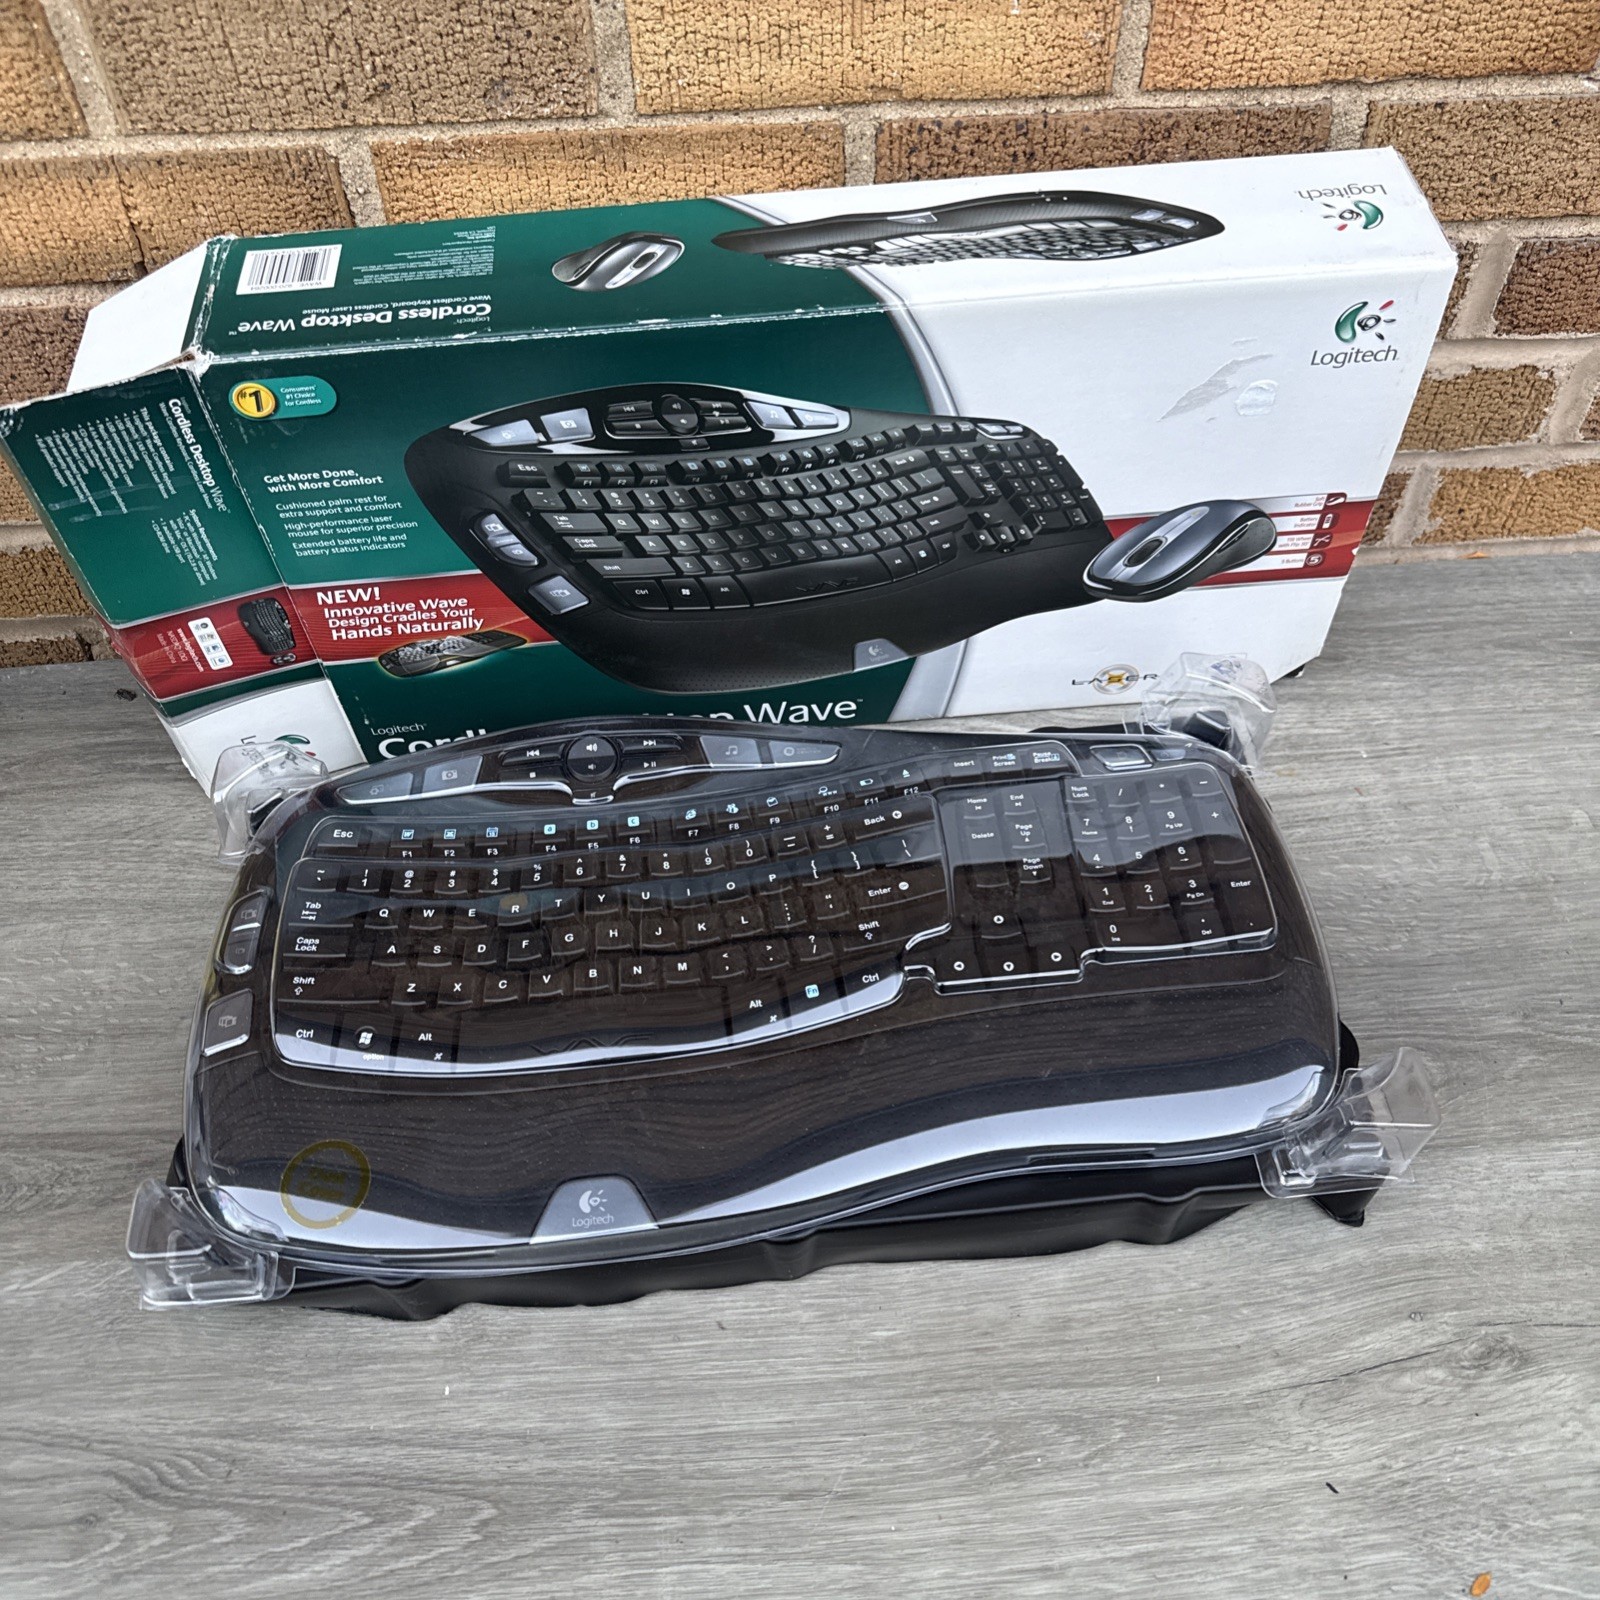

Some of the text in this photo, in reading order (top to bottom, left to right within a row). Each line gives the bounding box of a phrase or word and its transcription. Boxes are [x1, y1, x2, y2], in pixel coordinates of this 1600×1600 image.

[1298, 183, 1387, 201] Logitech
[391, 299, 431, 308] Keyboard,
[433, 296, 467, 304] Cordless
[354, 302, 388, 310] Cordless
[398, 303, 491, 320] Cordless
[301, 311, 393, 327] Desktop
[1310, 345, 1398, 369] Logitech
[294, 391, 315, 399] Choice
[295, 398, 322, 406] Cordless
[140, 407, 174, 471] This package contains
[169, 399, 196, 444] Cordless
[190, 444, 215, 486] Desktop
[159, 402, 169, 416] Wave
[166, 417, 179, 438] Cordless
[187, 461, 199, 481] Cordless
[197, 481, 205, 493] Laser
[203, 493, 212, 508] Mouse
[517, 464, 537, 472] Esc
[264, 470, 358, 484] Get More Done,
[268, 475, 384, 493] with More Comfort
[276, 500, 326, 511] Cushioned
[328, 498, 352, 507] palm
[279, 510, 303, 519] extra
[306, 507, 342, 518] support
[364, 501, 402, 511] comfort
[284, 515, 392, 531] High-performance laser
[288, 529, 319, 538] mouse
[336, 525, 374, 535] superior
[376, 521, 418, 531] precision
[189, 509, 217, 561] System Requirements
[292, 539, 335, 550] Extended
[338, 537, 371, 546] battery
[389, 533, 407, 541] and
[295, 541, 406, 557] battery status indicators
[317, 587, 380, 605] NEW!
[324, 598, 468, 618] Innovative Wave
[329, 607, 475, 628] Design Cradles Your
[332, 618, 484, 640] Hands Naturally
[904, 787, 919, 795] F12
[864, 797, 879, 805] F11
[824, 804, 839, 812] F10
[864, 815, 886, 826] Back
[333, 830, 353, 838] Esc
[769, 874, 776, 882] P
[642, 891, 650, 900] U
[868, 886, 892, 897] Enter
[598, 894, 606, 902] Y
[555, 899, 562, 907] T
[379, 909, 389, 918] Q
[423, 909, 435, 918] W
[468, 909, 476, 917] E
[511, 905, 520, 913] R
[741, 916, 748, 924] L
[698, 923, 706, 931] K
[858, 920, 880, 931] Shift
[609, 929, 618, 937] H
[655, 927, 662, 936] J
[296, 937, 320, 945] Caps
[564, 934, 574, 942] G
[522, 940, 529, 948] F
[387, 945, 396, 954] A
[433, 946, 441, 954] S
[477, 945, 486, 953] D
[633, 966, 642, 974] N
[678, 963, 688, 971] M
[589, 969, 597, 977] B
[543, 975, 551, 983] V
[862, 974, 879, 983] Ctrl
[407, 983, 416, 992] Z
[453, 983, 462, 991] X
[499, 980, 507, 989] C
[807, 987, 817, 995] Fn
[749, 1000, 762, 1008] Alt
[296, 1030, 314, 1038] Ctrl
[418, 1033, 432, 1041] Alt
[571, 1213, 614, 1229] Logitech
